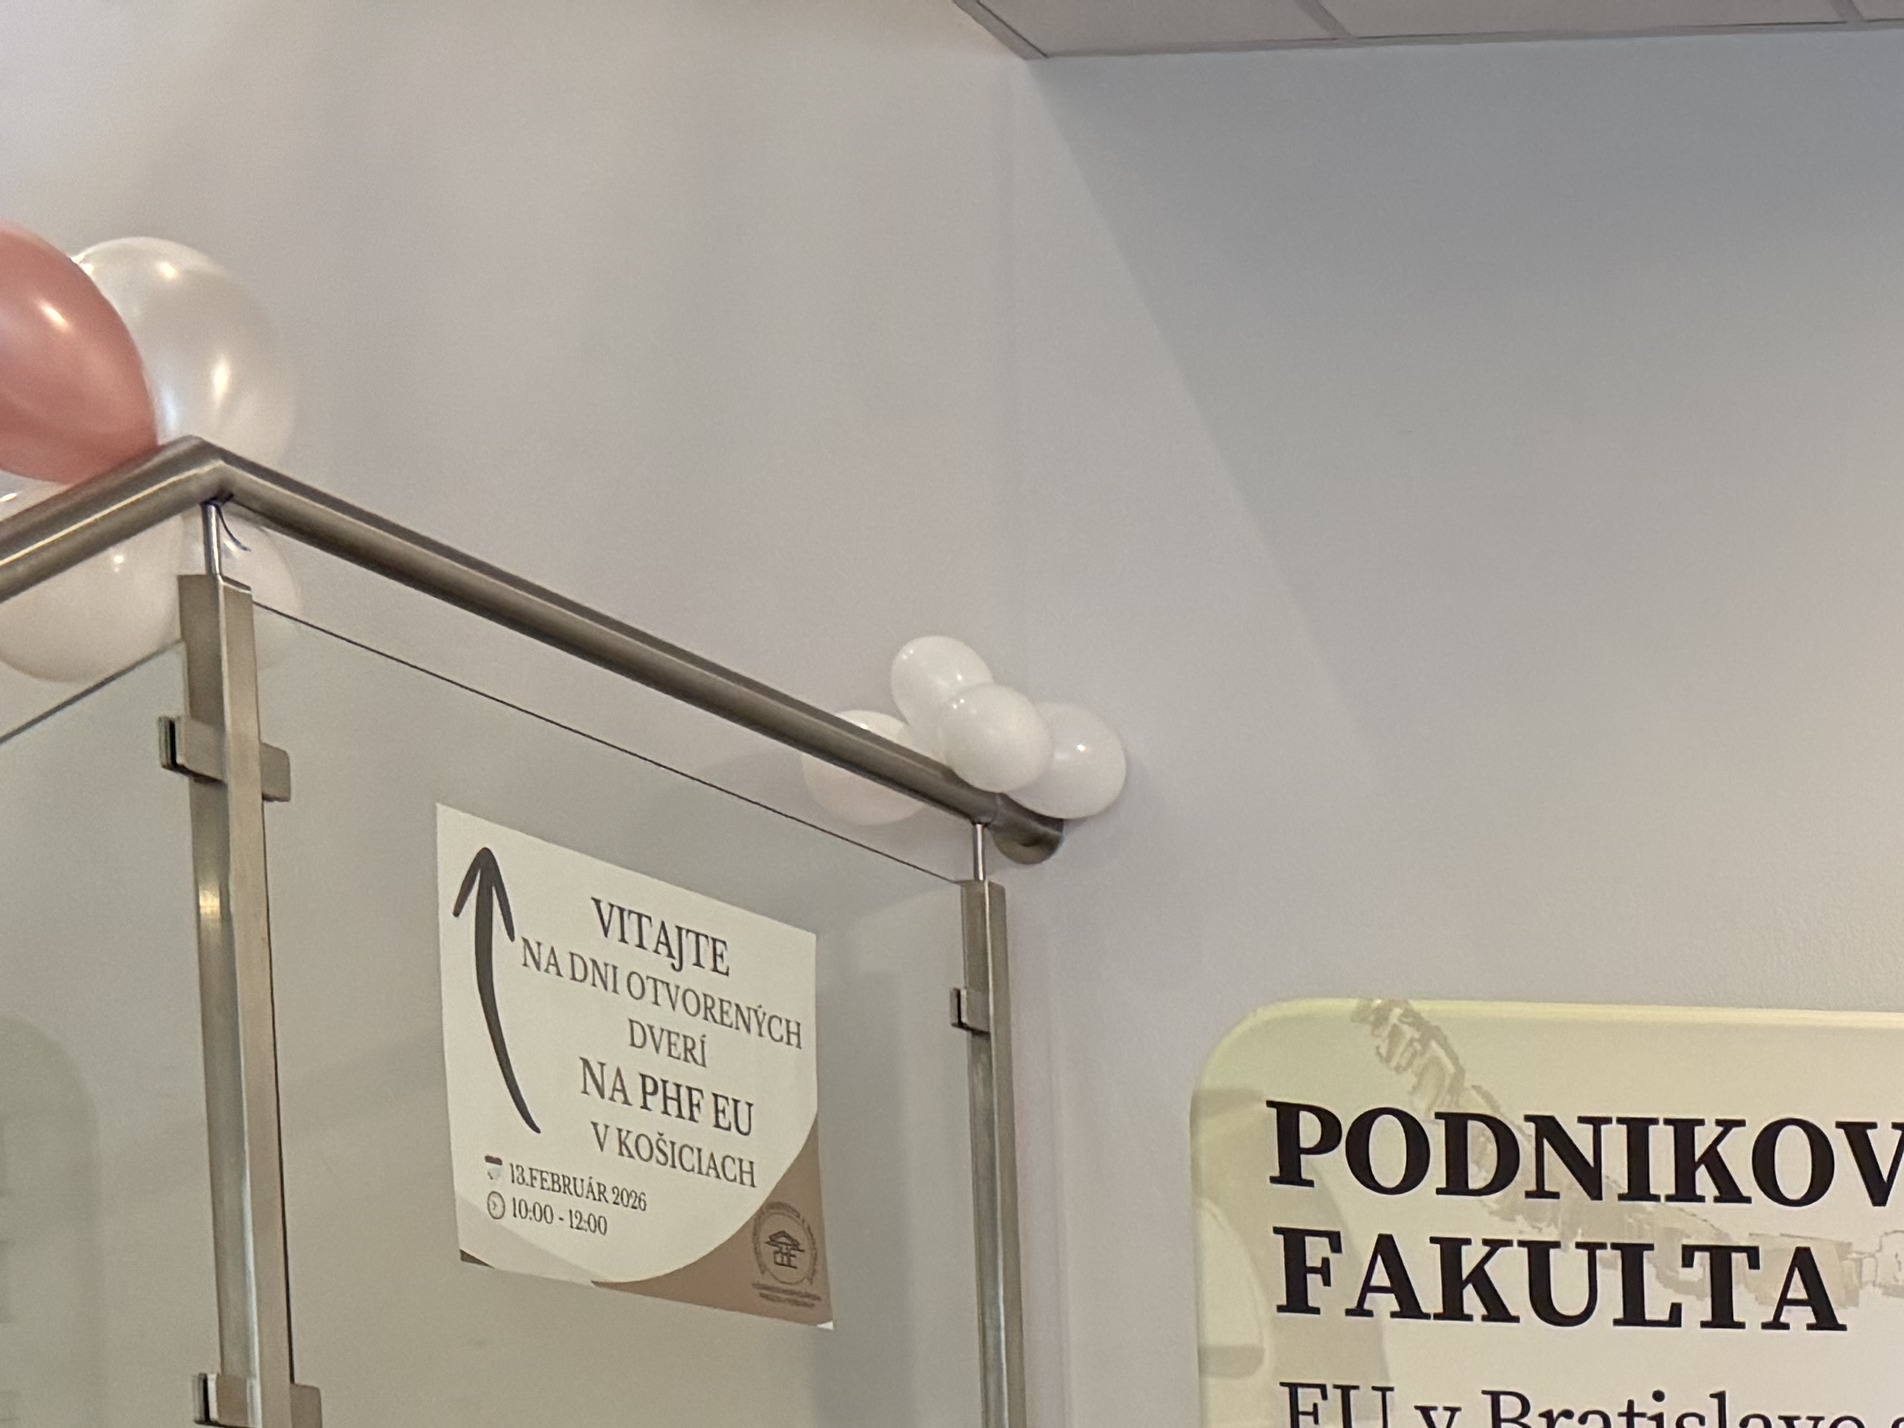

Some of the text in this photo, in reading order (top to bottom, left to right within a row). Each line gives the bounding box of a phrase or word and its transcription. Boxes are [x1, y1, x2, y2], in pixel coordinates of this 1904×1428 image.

[591, 896, 731, 977] VITAJTE
[521, 937, 803, 1049] NA DNI OTVORENÝCH
[627, 1018, 708, 1069] DVERÍ
[580, 1057, 755, 1137] NA PHF EU
[590, 1121, 758, 1188] V KOŠICIACH
[512, 1197, 554, 1225] 10:00
[568, 1209, 608, 1236] 12:00
[612, 1186, 648, 1211] 2026
[1272, 1226, 1848, 1332] FAKULTA
